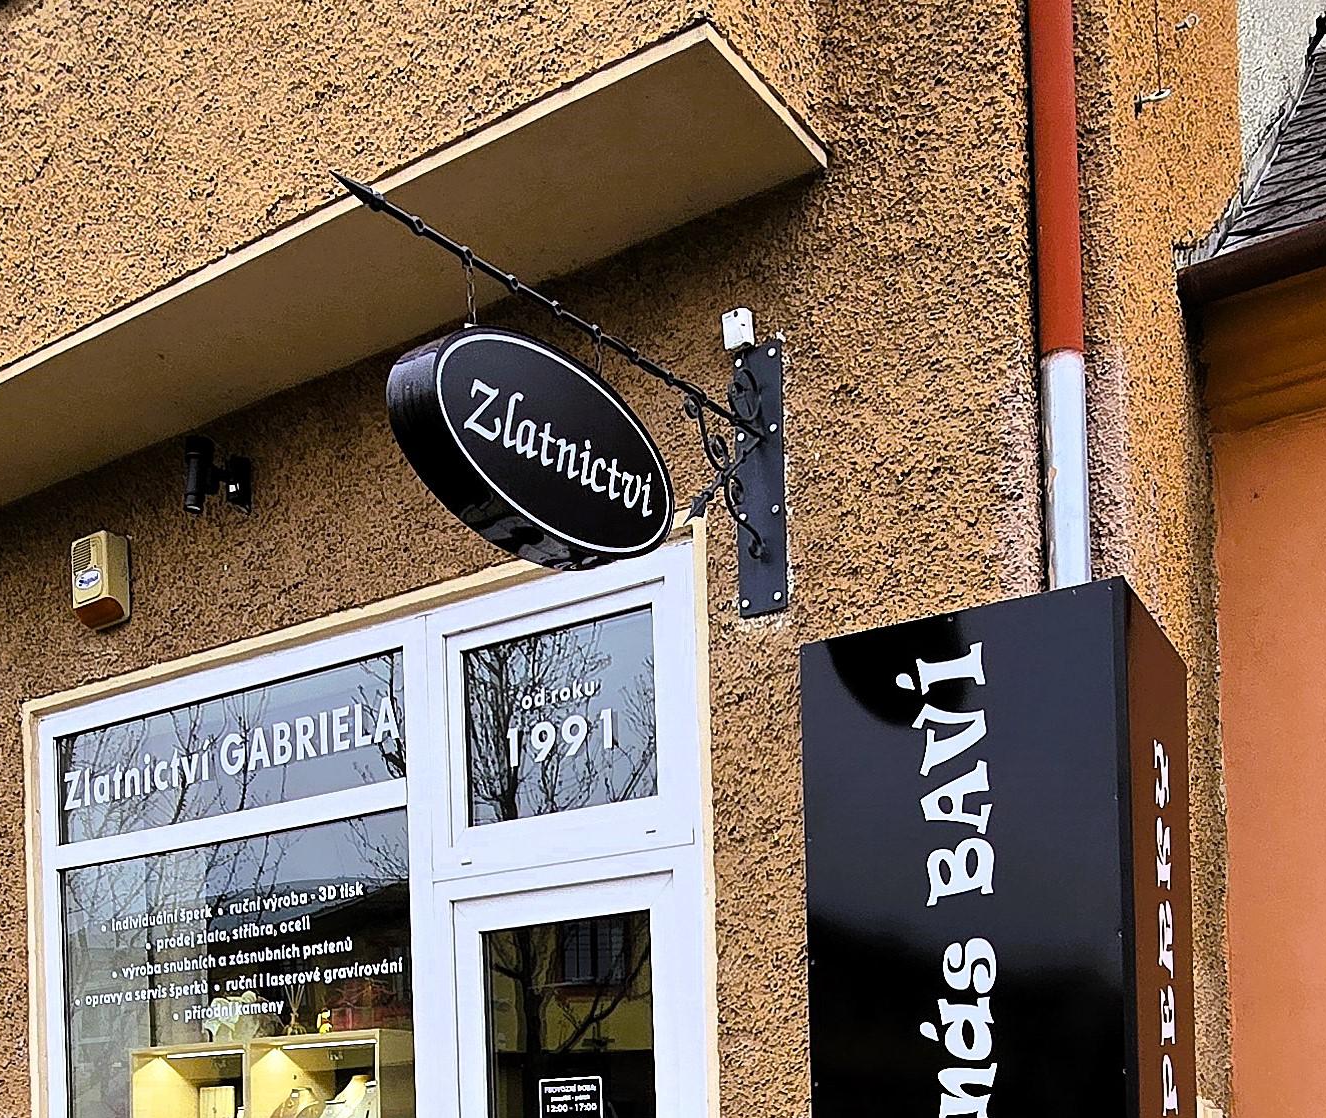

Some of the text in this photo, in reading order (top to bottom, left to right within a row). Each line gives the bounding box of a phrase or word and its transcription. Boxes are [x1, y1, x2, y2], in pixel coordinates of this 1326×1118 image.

[521, 679, 595, 710] od roku
[63, 696, 401, 812] Zlatnictví GABRIELA
[506, 708, 614, 768] 1991
[895, 641, 995, 907] BAVÍ
[111, 881, 365, 932] individuální šperk ruční výroba 3D tisk
[156, 915, 311, 952] prodej zlata, stříbra, oceli
[121, 936, 353, 980] výroba snubních a zásnubních prstenů
[85, 990, 123, 1008] opravy
[125, 991, 133, 1002] a
[134, 984, 168, 1001] servis
[169, 978, 209, 997] šperků
[225, 975, 257, 993] ruční
[266, 966, 322, 987] laserové
[235, 1000, 284, 1017] kameny
[546, 1103, 569, 1113] 12:00
[575, 1102, 598, 1112] 17:00
